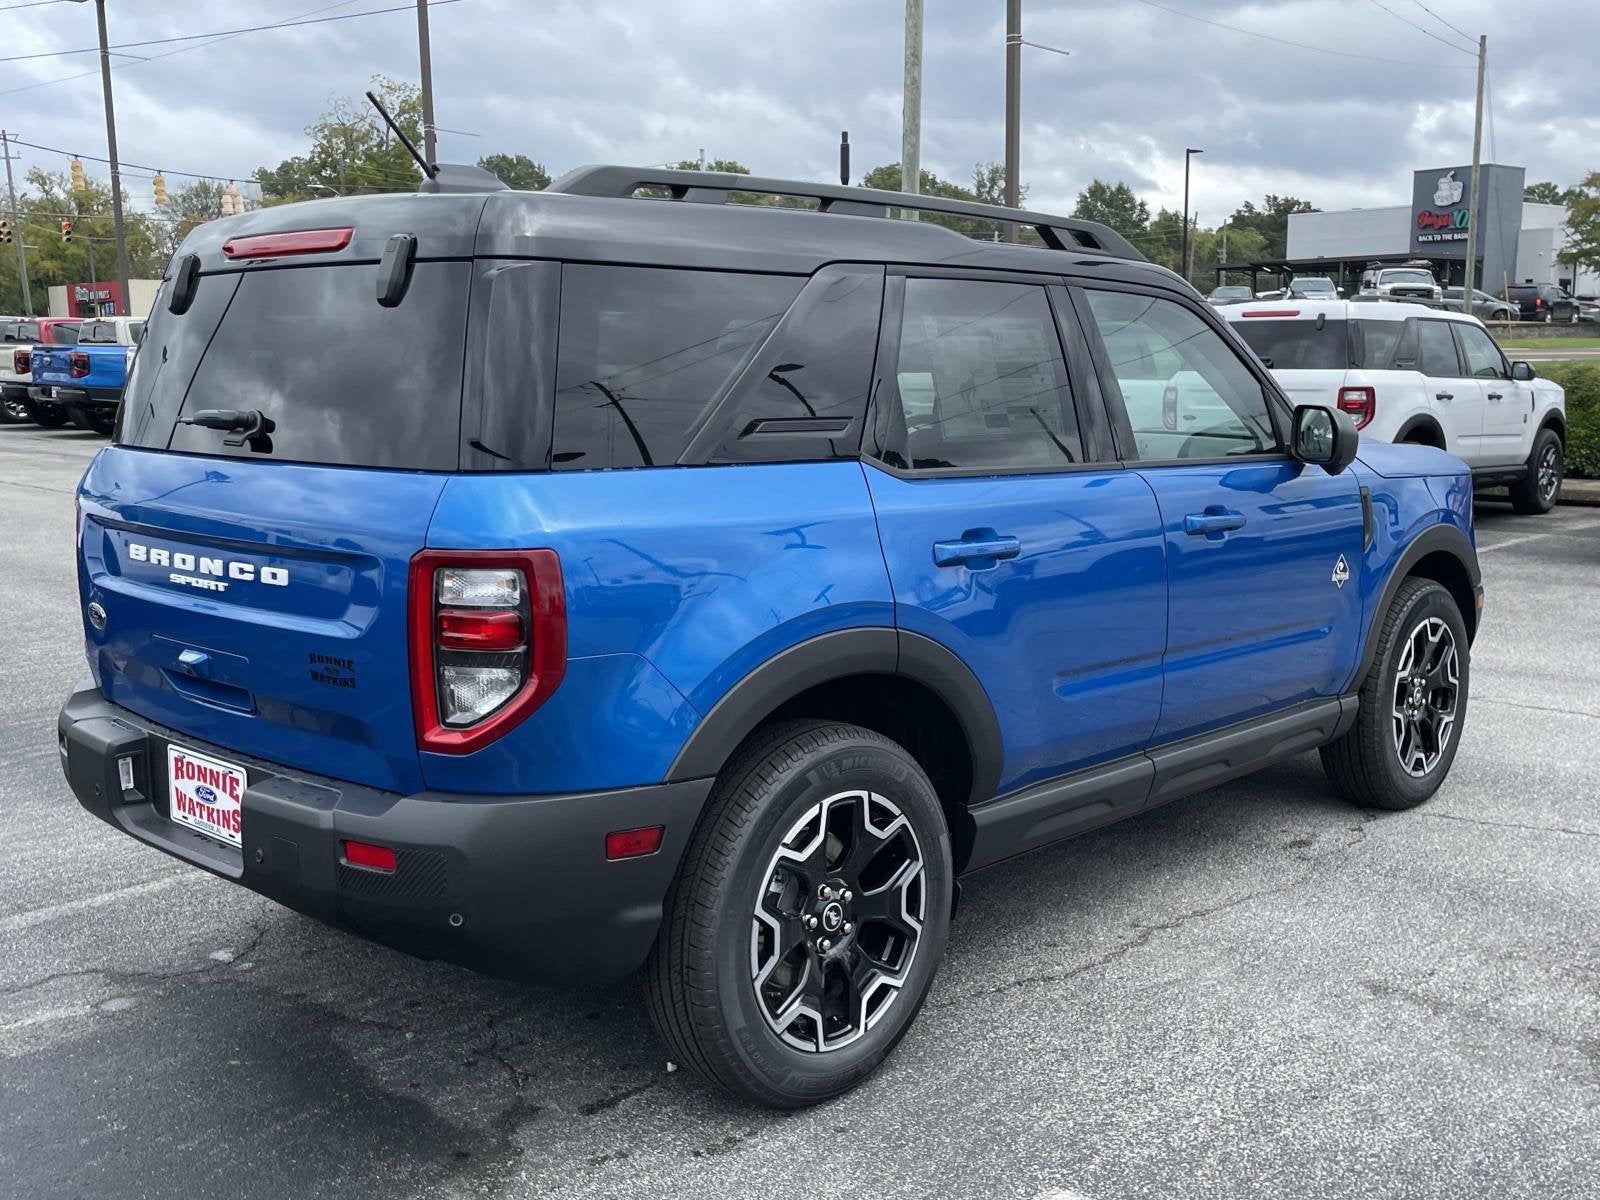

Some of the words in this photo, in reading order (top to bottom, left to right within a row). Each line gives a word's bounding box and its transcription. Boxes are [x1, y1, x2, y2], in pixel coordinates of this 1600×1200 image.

[1449, 209, 1469, 229] 10
[1453, 232, 1469, 240] BASI
[129, 543, 289, 586] BRONCO
[169, 573, 229, 592] SPORT
[308, 652, 355, 671] RONNIE
[310, 669, 356, 689] WATKINS
[173, 756, 241, 804] RONNIE
[197, 786, 217, 803] Ford
[174, 784, 242, 834] WATKINS
